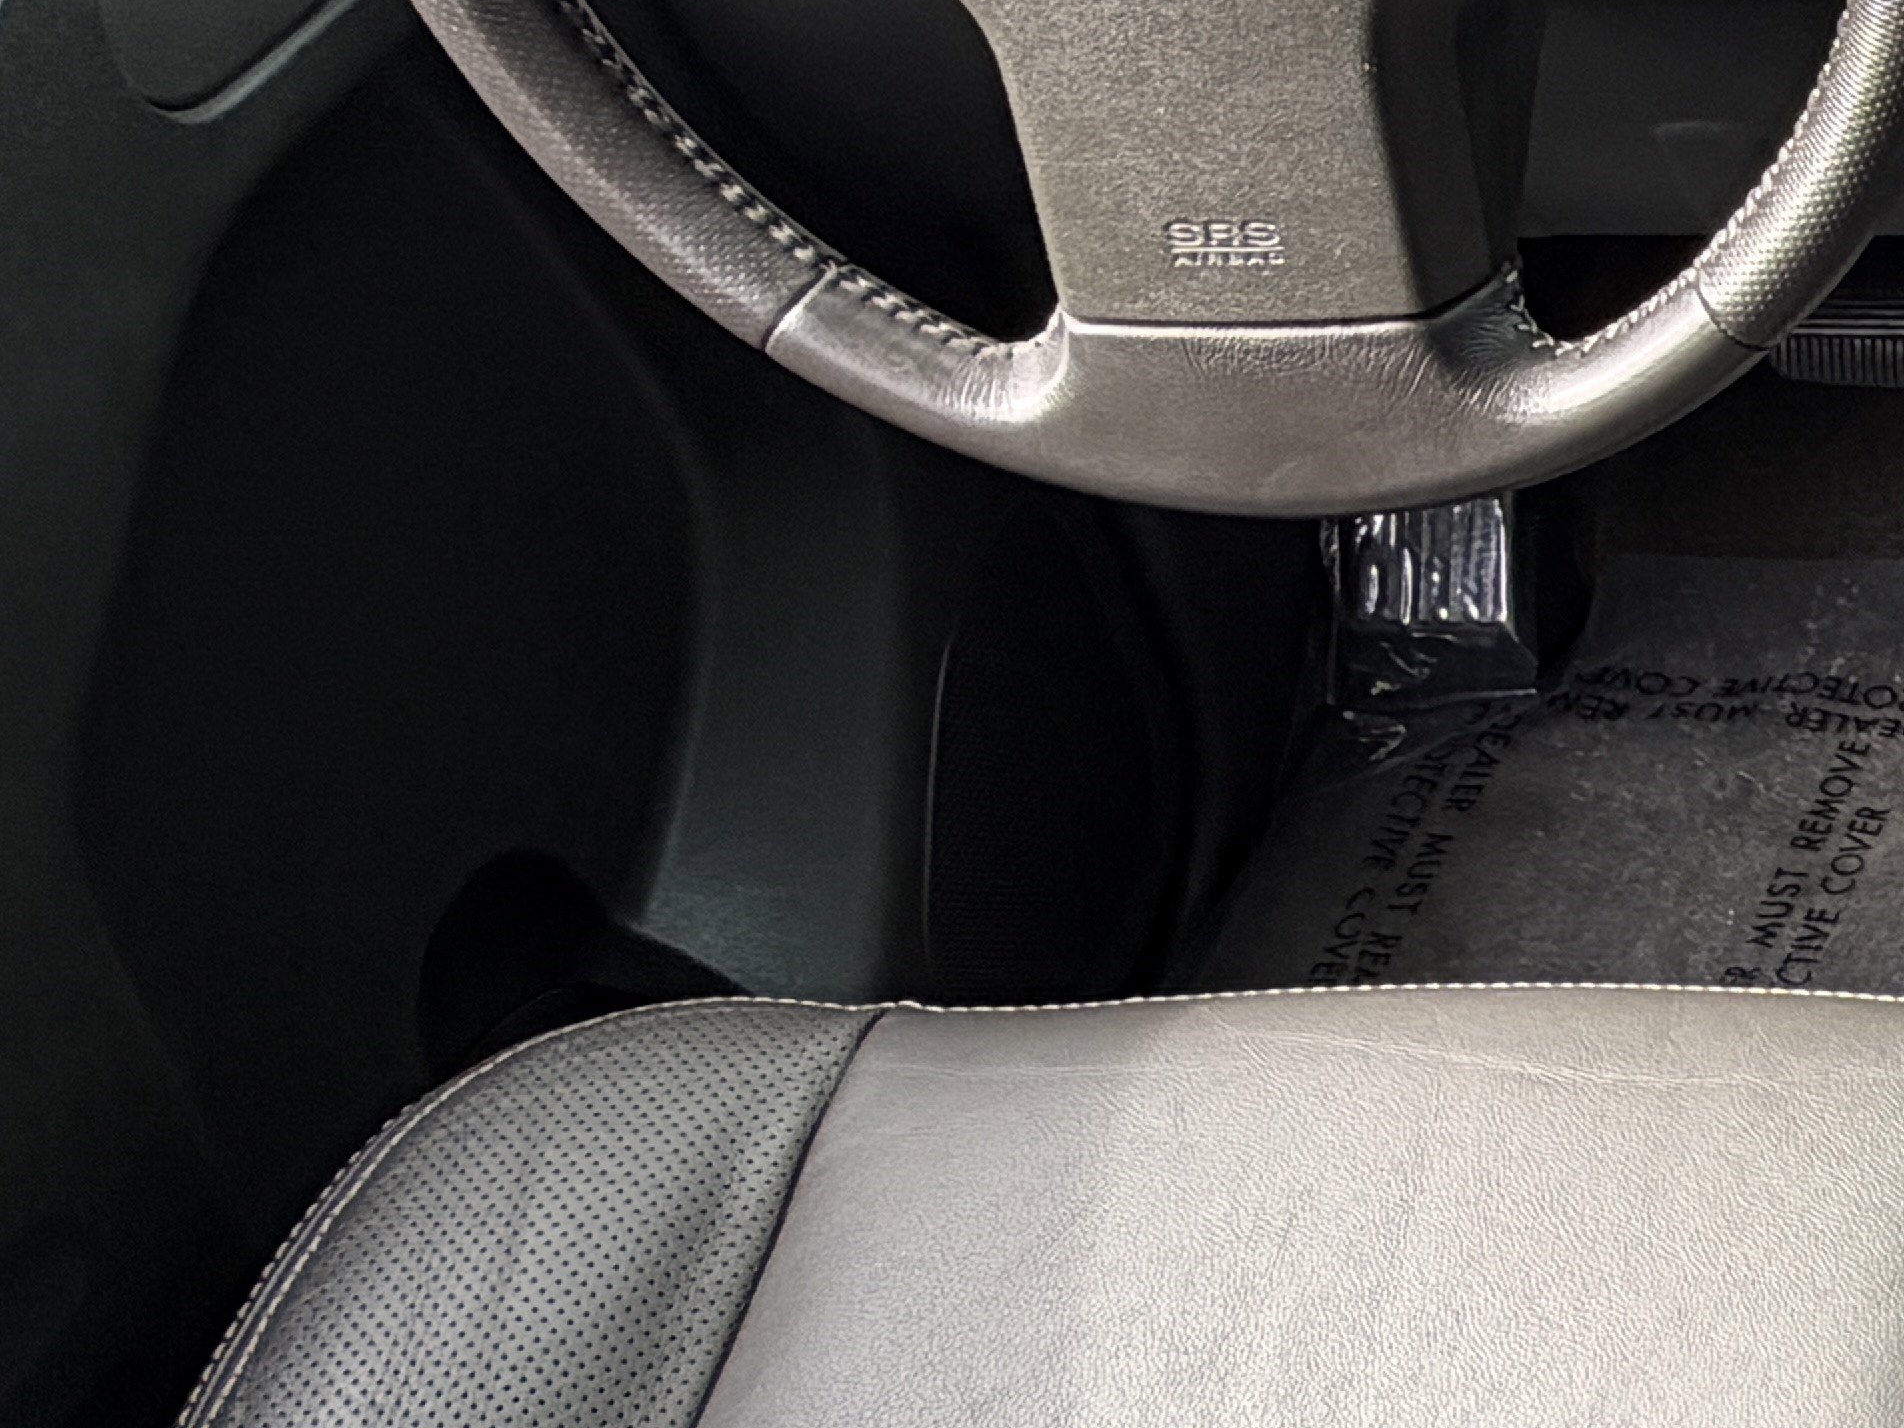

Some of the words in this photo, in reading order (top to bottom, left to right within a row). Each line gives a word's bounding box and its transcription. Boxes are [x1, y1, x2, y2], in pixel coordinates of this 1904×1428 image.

[1163, 217, 1281, 247] SRS
[1387, 832, 1454, 915] MUST
[1746, 866, 1810, 948] MUST
[1790, 739, 1873, 852] REMOVE
[1821, 805, 1892, 896] COVER
